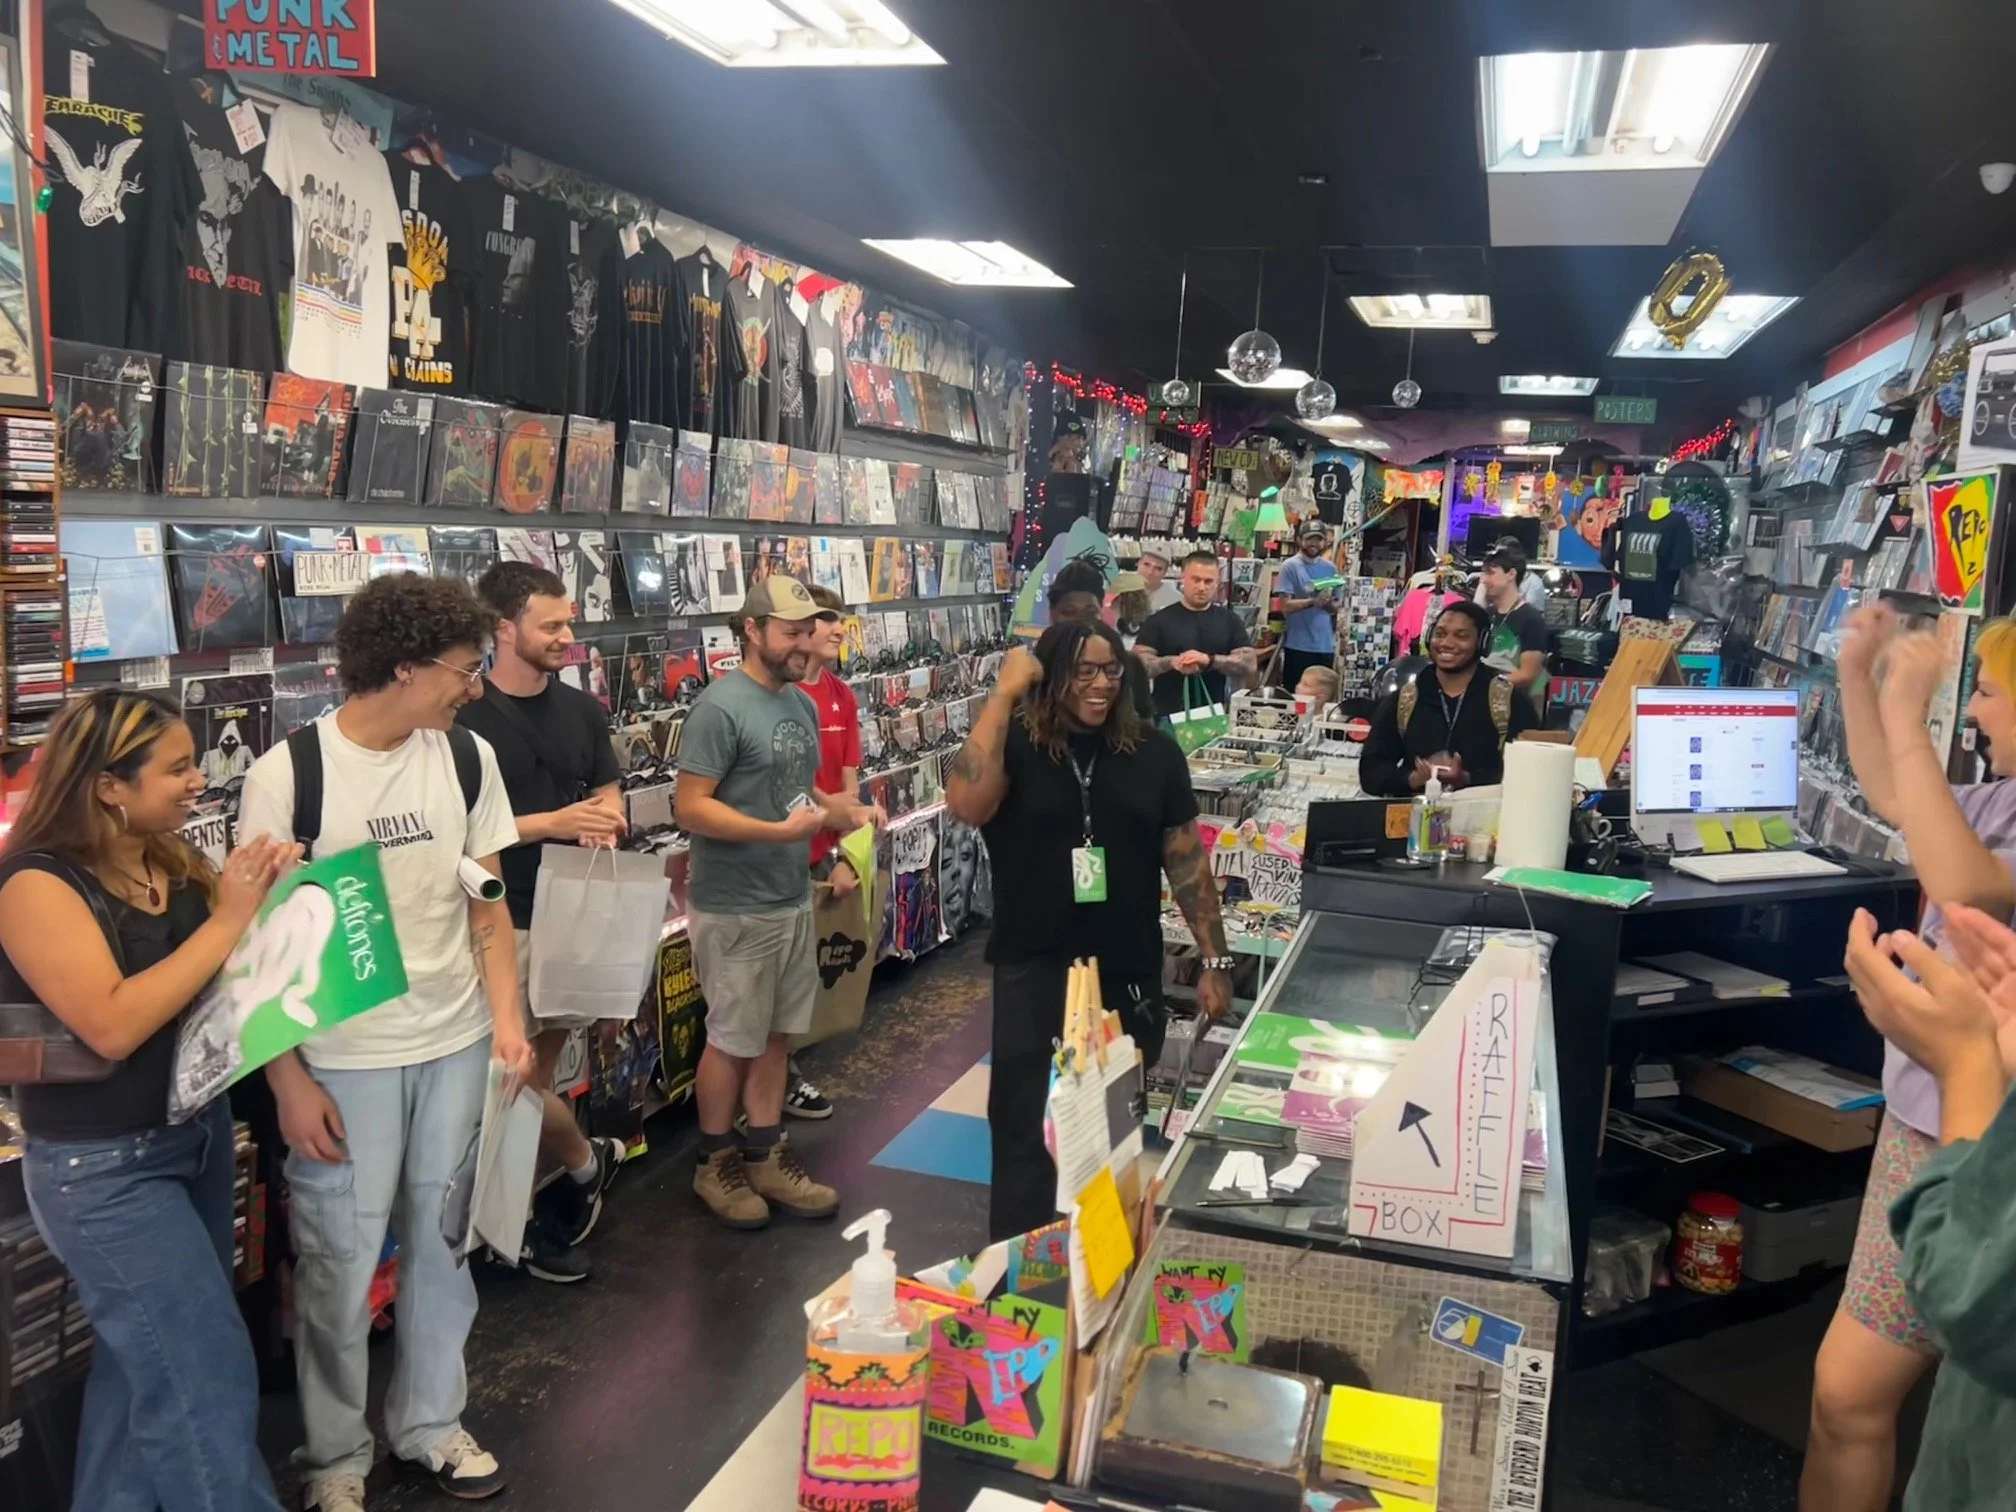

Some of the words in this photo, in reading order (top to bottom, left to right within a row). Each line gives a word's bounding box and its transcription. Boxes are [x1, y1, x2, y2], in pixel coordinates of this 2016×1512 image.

[215, 0, 358, 30] PUNK
[226, 30, 360, 71] METAL
[1597, 401, 1654, 421] POSTERS
[1552, 680, 1602, 705] JAZ
[366, 809, 428, 842] NIRVANA
[1259, 857, 1288, 869] USED
[1473, 993, 1509, 1216] RAFFLE
[1381, 1201, 1444, 1239] BOX
[1517, 1371, 1548, 1399] HEAT
[1514, 1398, 1545, 1440] HORTON
[818, 1414, 915, 1460] REPO
[1508, 1439, 1540, 1490] REVEREND
[1507, 1488, 1535, 1511] THE
